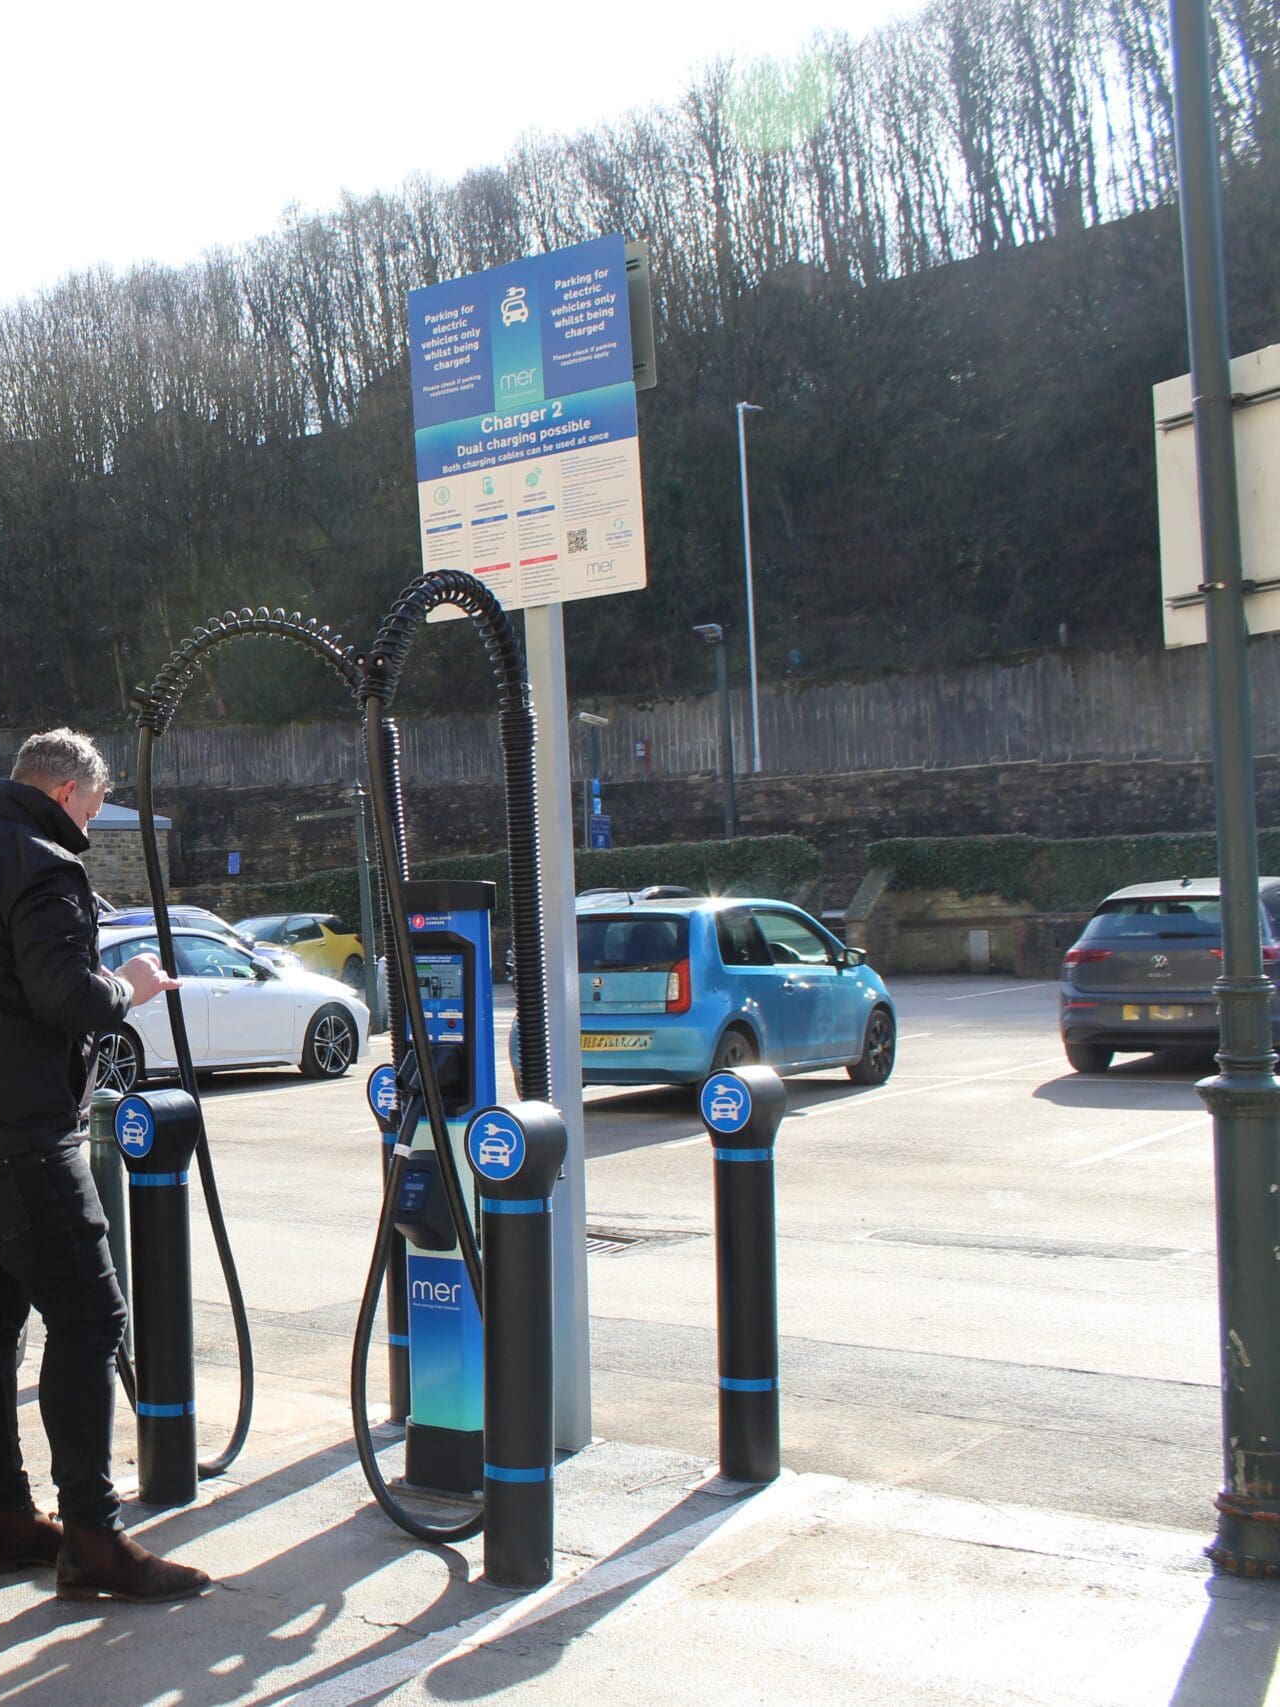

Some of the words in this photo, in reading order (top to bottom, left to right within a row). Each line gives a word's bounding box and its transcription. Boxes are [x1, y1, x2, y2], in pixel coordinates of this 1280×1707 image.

[554, 273, 592, 290] Parking
[594, 268, 610, 280] for
[563, 284, 602, 300] electric
[425, 308, 459, 325] Parking
[461, 304, 474, 315] for
[550, 298, 592, 316] vehicles
[594, 293, 616, 306] only
[433, 318, 468, 334] electric
[554, 313, 584, 328] whilst
[587, 307, 614, 320] being
[421, 332, 458, 349] vehicles
[461, 328, 481, 340] only
[565, 321, 605, 339] charged
[424, 346, 452, 361] whilst
[454, 341, 479, 354] being
[572, 348, 588, 357] check
[596, 342, 617, 352] parking
[594, 351, 609, 360] apply
[434, 354, 471, 371] charged
[501, 368, 536, 391] mer
[481, 407, 547, 434] Charger
[552, 401, 563, 418] 2
[457, 442, 483, 457] Dual
[486, 430, 537, 450] charging
[540, 419, 592, 439] possible
[442, 462, 461, 474] Both
[462, 455, 496, 470] charging
[498, 450, 524, 462] cables
[526, 447, 541, 456] can
[543, 443, 553, 453] be
[555, 440, 575, 451] used
[577, 436, 586, 445] at
[589, 432, 609, 443] once
[586, 560, 616, 576] mer
[412, 1280, 461, 1303] mer
